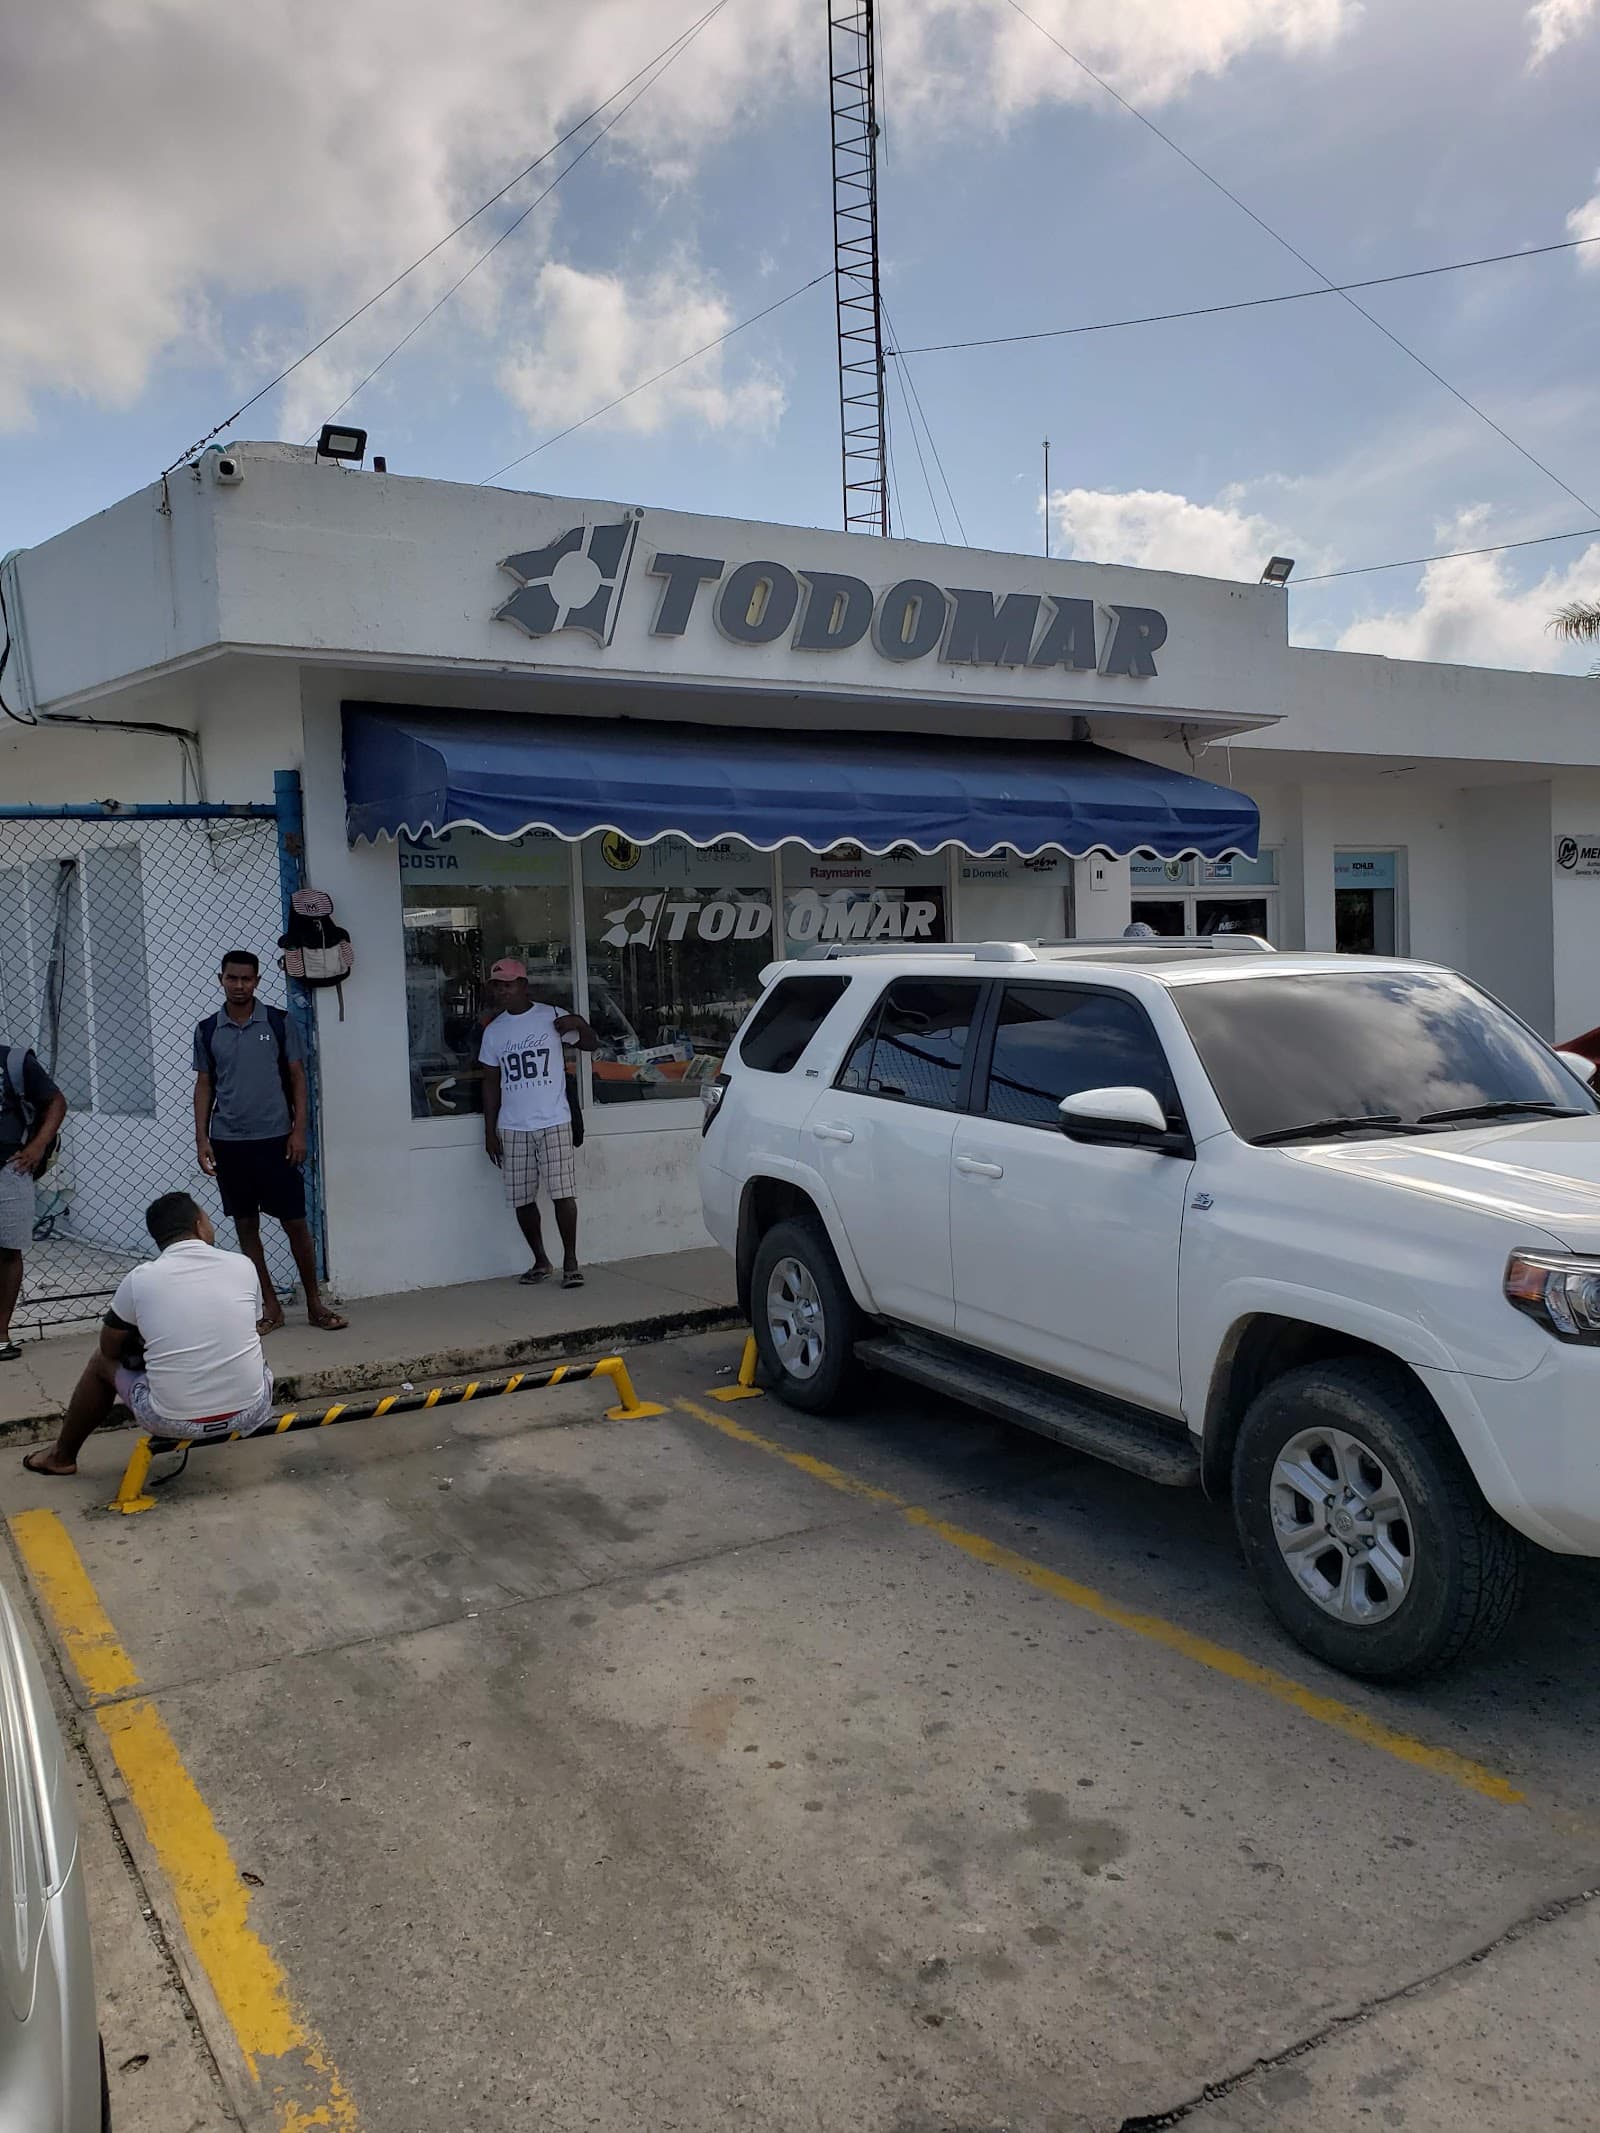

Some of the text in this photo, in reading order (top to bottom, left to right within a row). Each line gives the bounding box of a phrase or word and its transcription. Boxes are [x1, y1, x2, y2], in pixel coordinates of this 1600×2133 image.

[647, 552, 1168, 678] TODOMAR
[399, 854, 459, 870] COSTA
[810, 866, 871, 880] Raymarine
[972, 868, 1009, 878] Dometic
[501, 1047, 550, 1084] 1967
